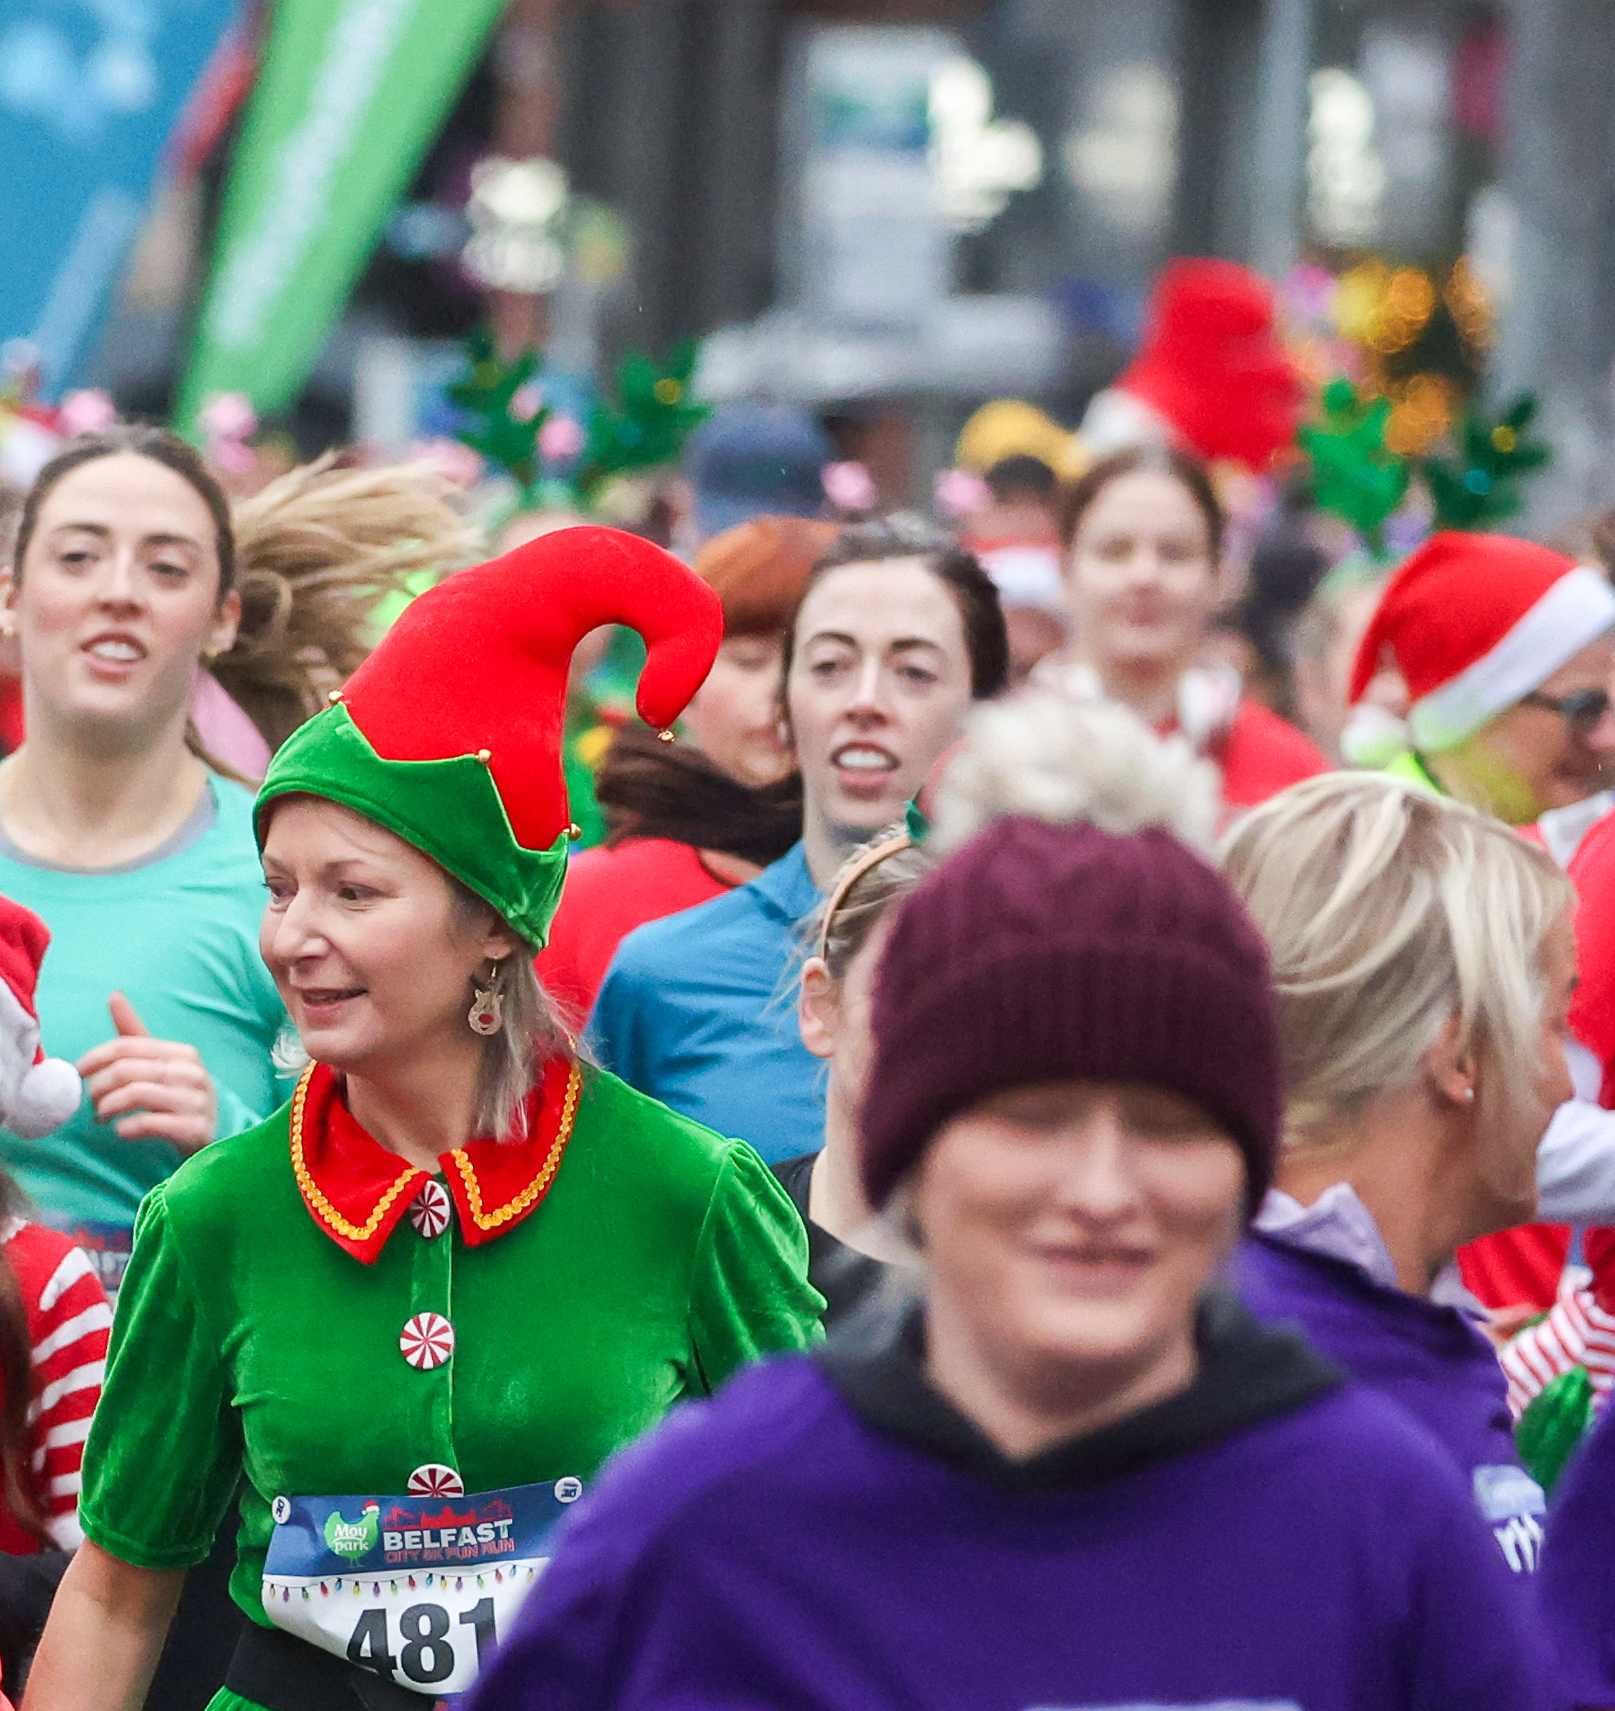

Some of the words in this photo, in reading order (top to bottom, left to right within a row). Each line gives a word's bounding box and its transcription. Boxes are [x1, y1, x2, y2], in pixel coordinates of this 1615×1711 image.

[334, 1523, 368, 1541] Moy
[383, 1518, 513, 1552] BELFAST
[333, 1537, 369, 1552] park
[446, 1544, 479, 1559] FUN
[346, 1597, 499, 1684] 481
